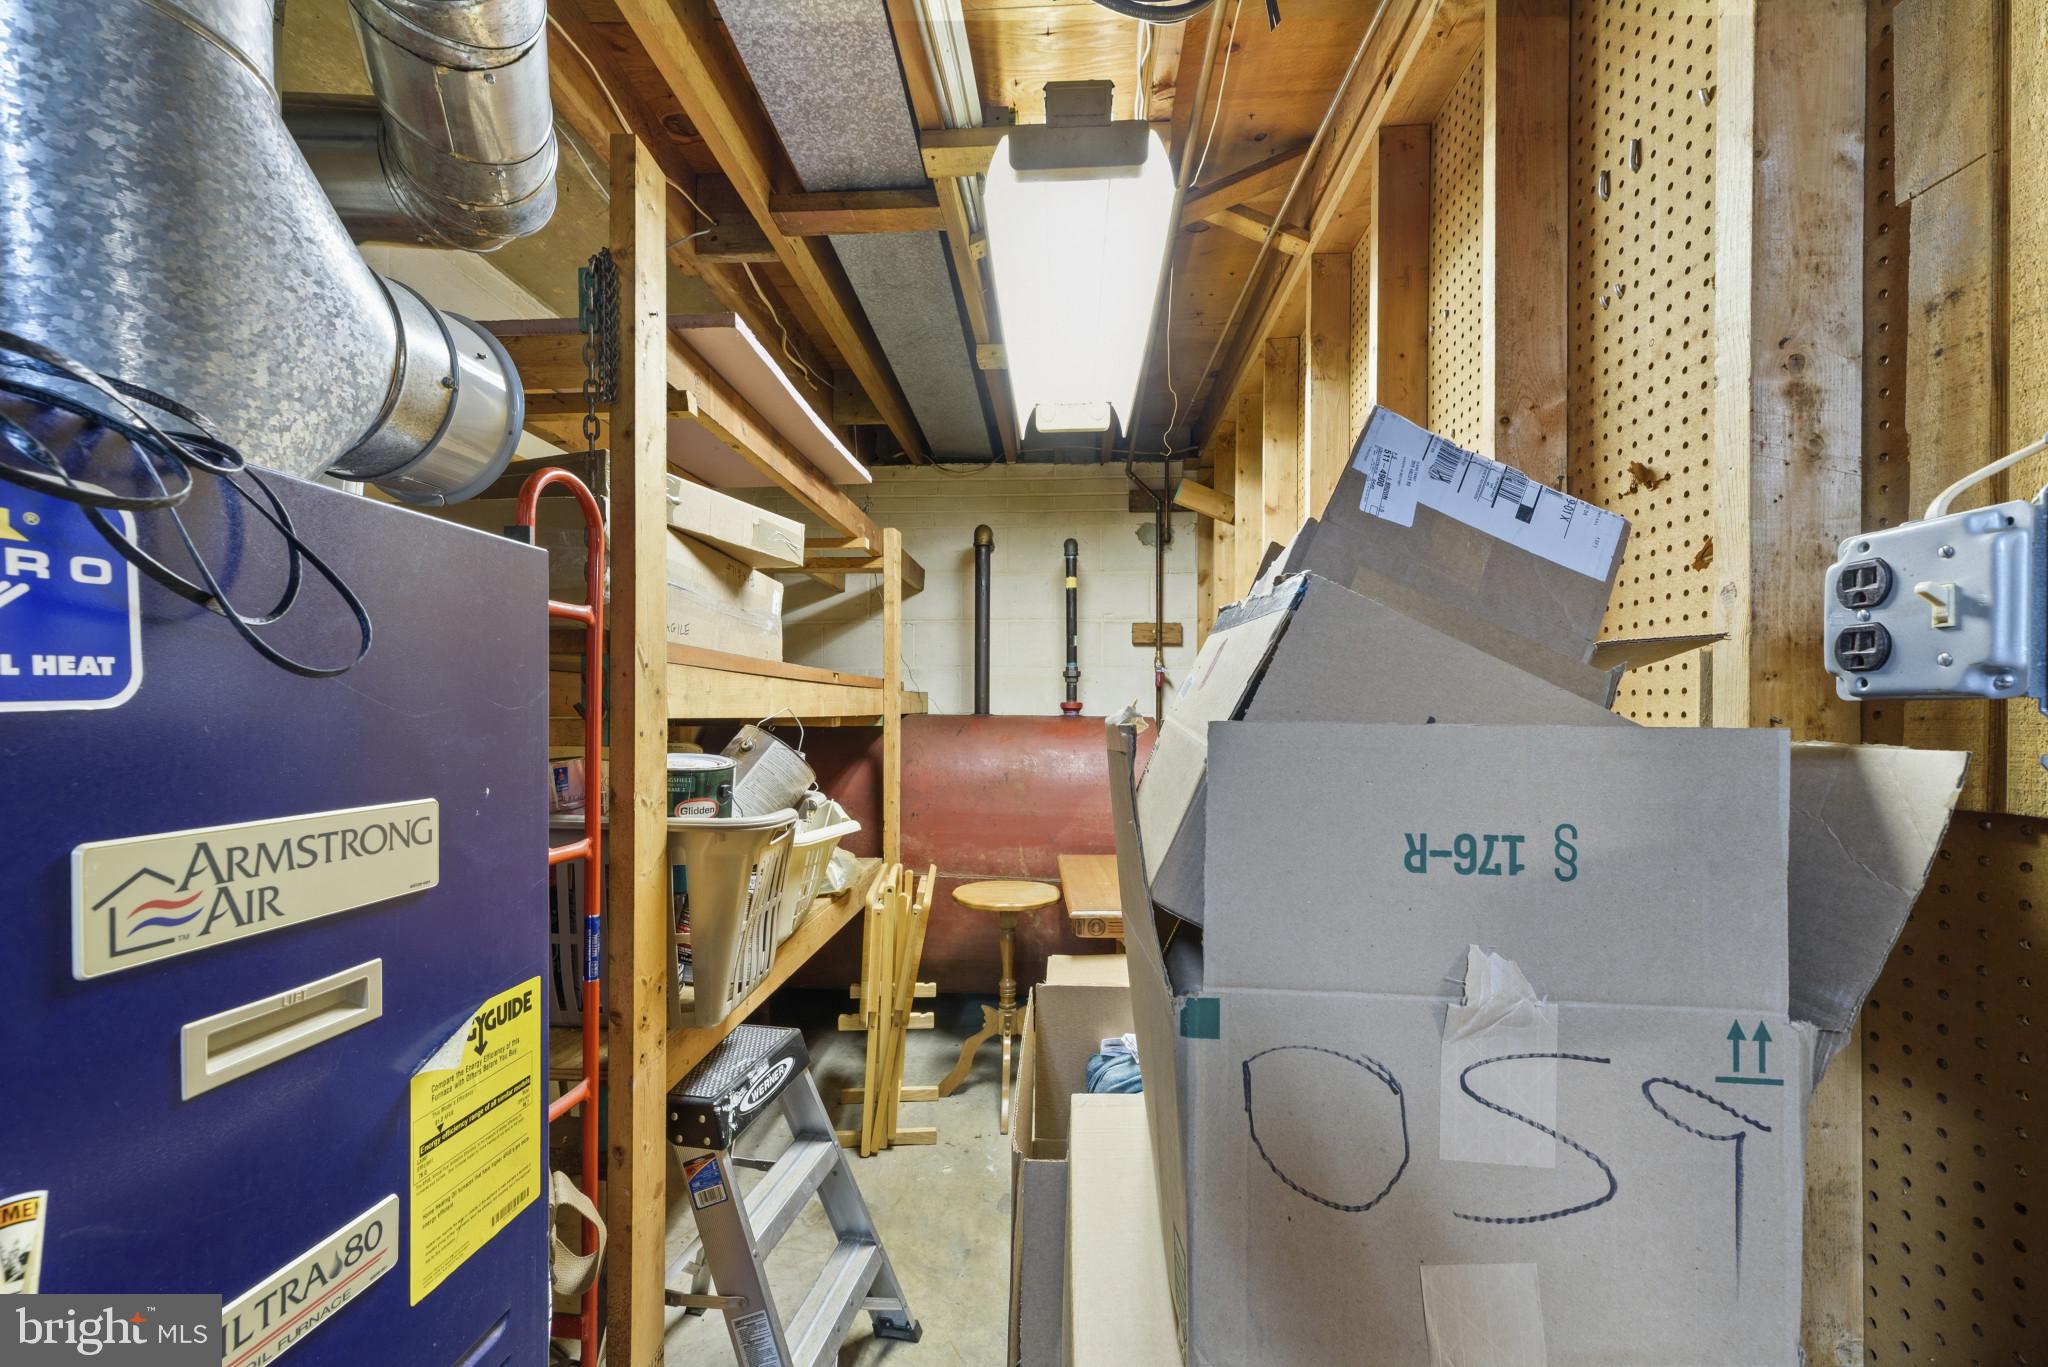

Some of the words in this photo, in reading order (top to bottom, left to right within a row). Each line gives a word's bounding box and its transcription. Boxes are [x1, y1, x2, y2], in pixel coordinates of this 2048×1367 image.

[32, 654, 116, 676] HEAT
[680, 806, 715, 816] Glidden
[174, 816, 433, 893] ARMSTRONG
[1403, 832, 1525, 876] 176-R
[197, 885, 286, 937] AIR
[751, 1065, 786, 1102] WERNER
[343, 1220, 383, 1268] 80
[277, 1288, 352, 1351] FURNACE
